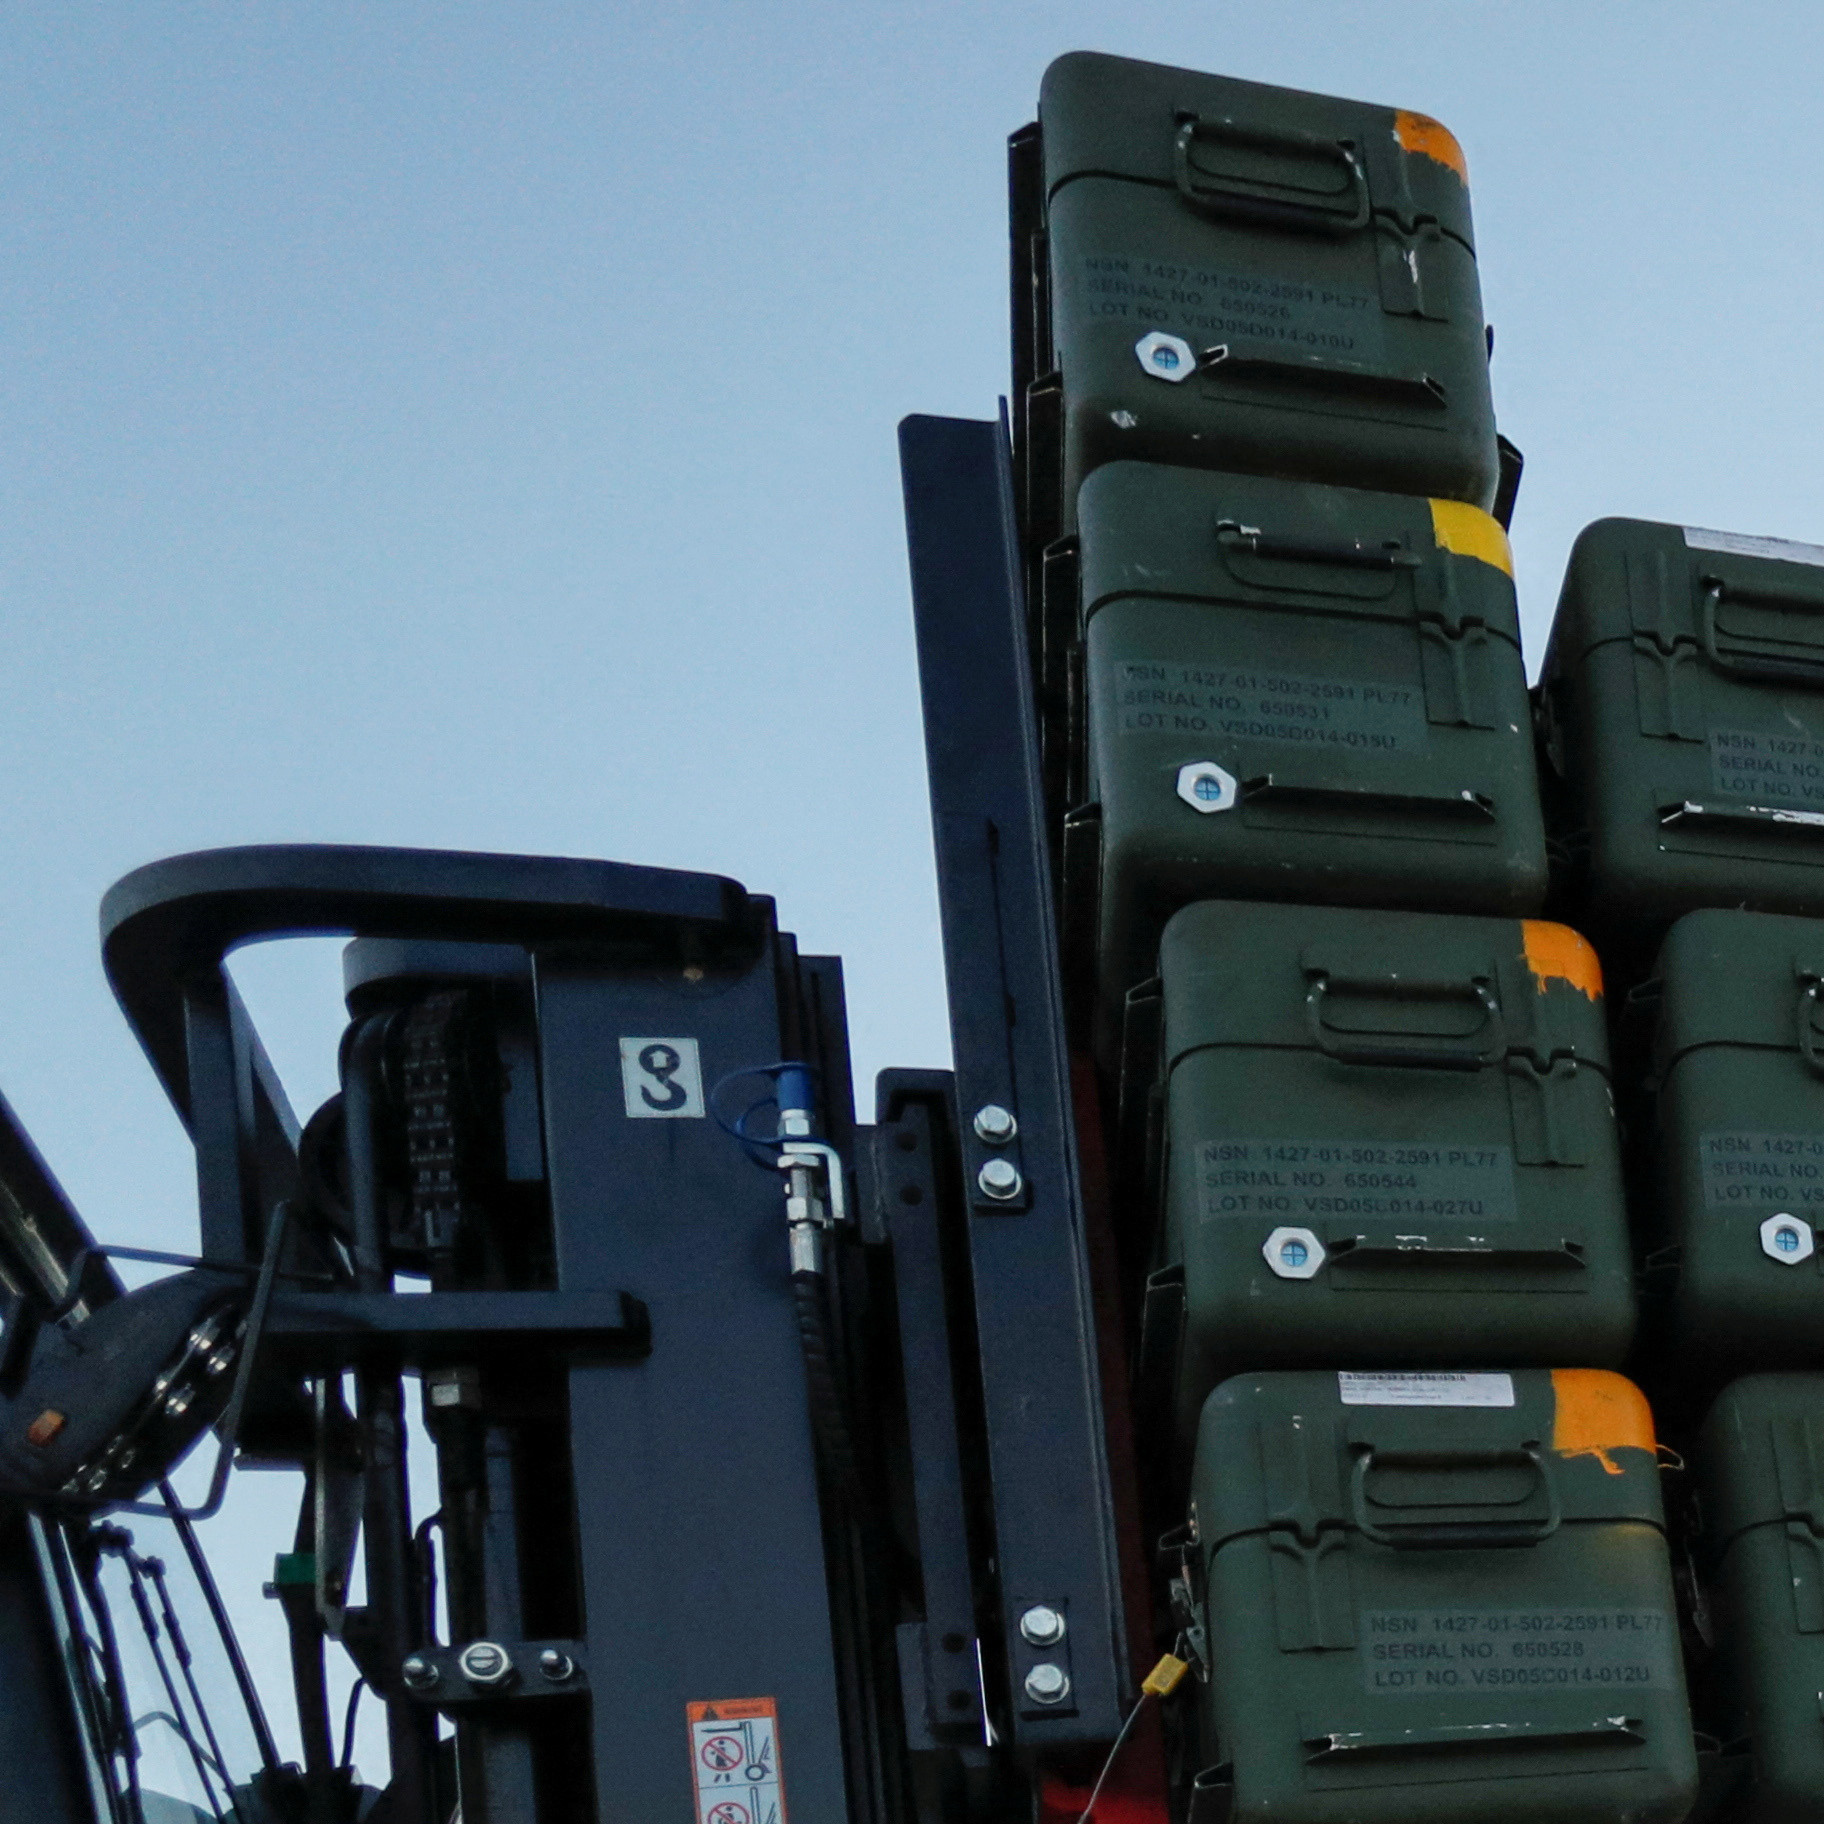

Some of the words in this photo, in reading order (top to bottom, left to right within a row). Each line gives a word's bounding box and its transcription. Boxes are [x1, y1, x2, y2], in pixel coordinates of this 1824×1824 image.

[1088, 277, 1163, 300] SERIAL
[1089, 302, 1128, 317] LOT
[1124, 690, 1205, 708] SERIAL
[1125, 713, 1167, 728] LOT
[1717, 734, 1755, 749] NSN
[1719, 755, 1788, 774] SERIAL
[1721, 777, 1758, 792] LOT
[1709, 1137, 1750, 1153] NSN
[1204, 1146, 1248, 1162] NSN
[1713, 1162, 1784, 1178] SERIAL
[1205, 1171, 1286, 1188] SERIAL
[1714, 1184, 1752, 1200] LOT
[1208, 1196, 1249, 1213] LOT
[1371, 1617, 1417, 1633] NSN
[1373, 1643, 1453, 1660] SERIAL
[1375, 1670, 1417, 1687] LOT
